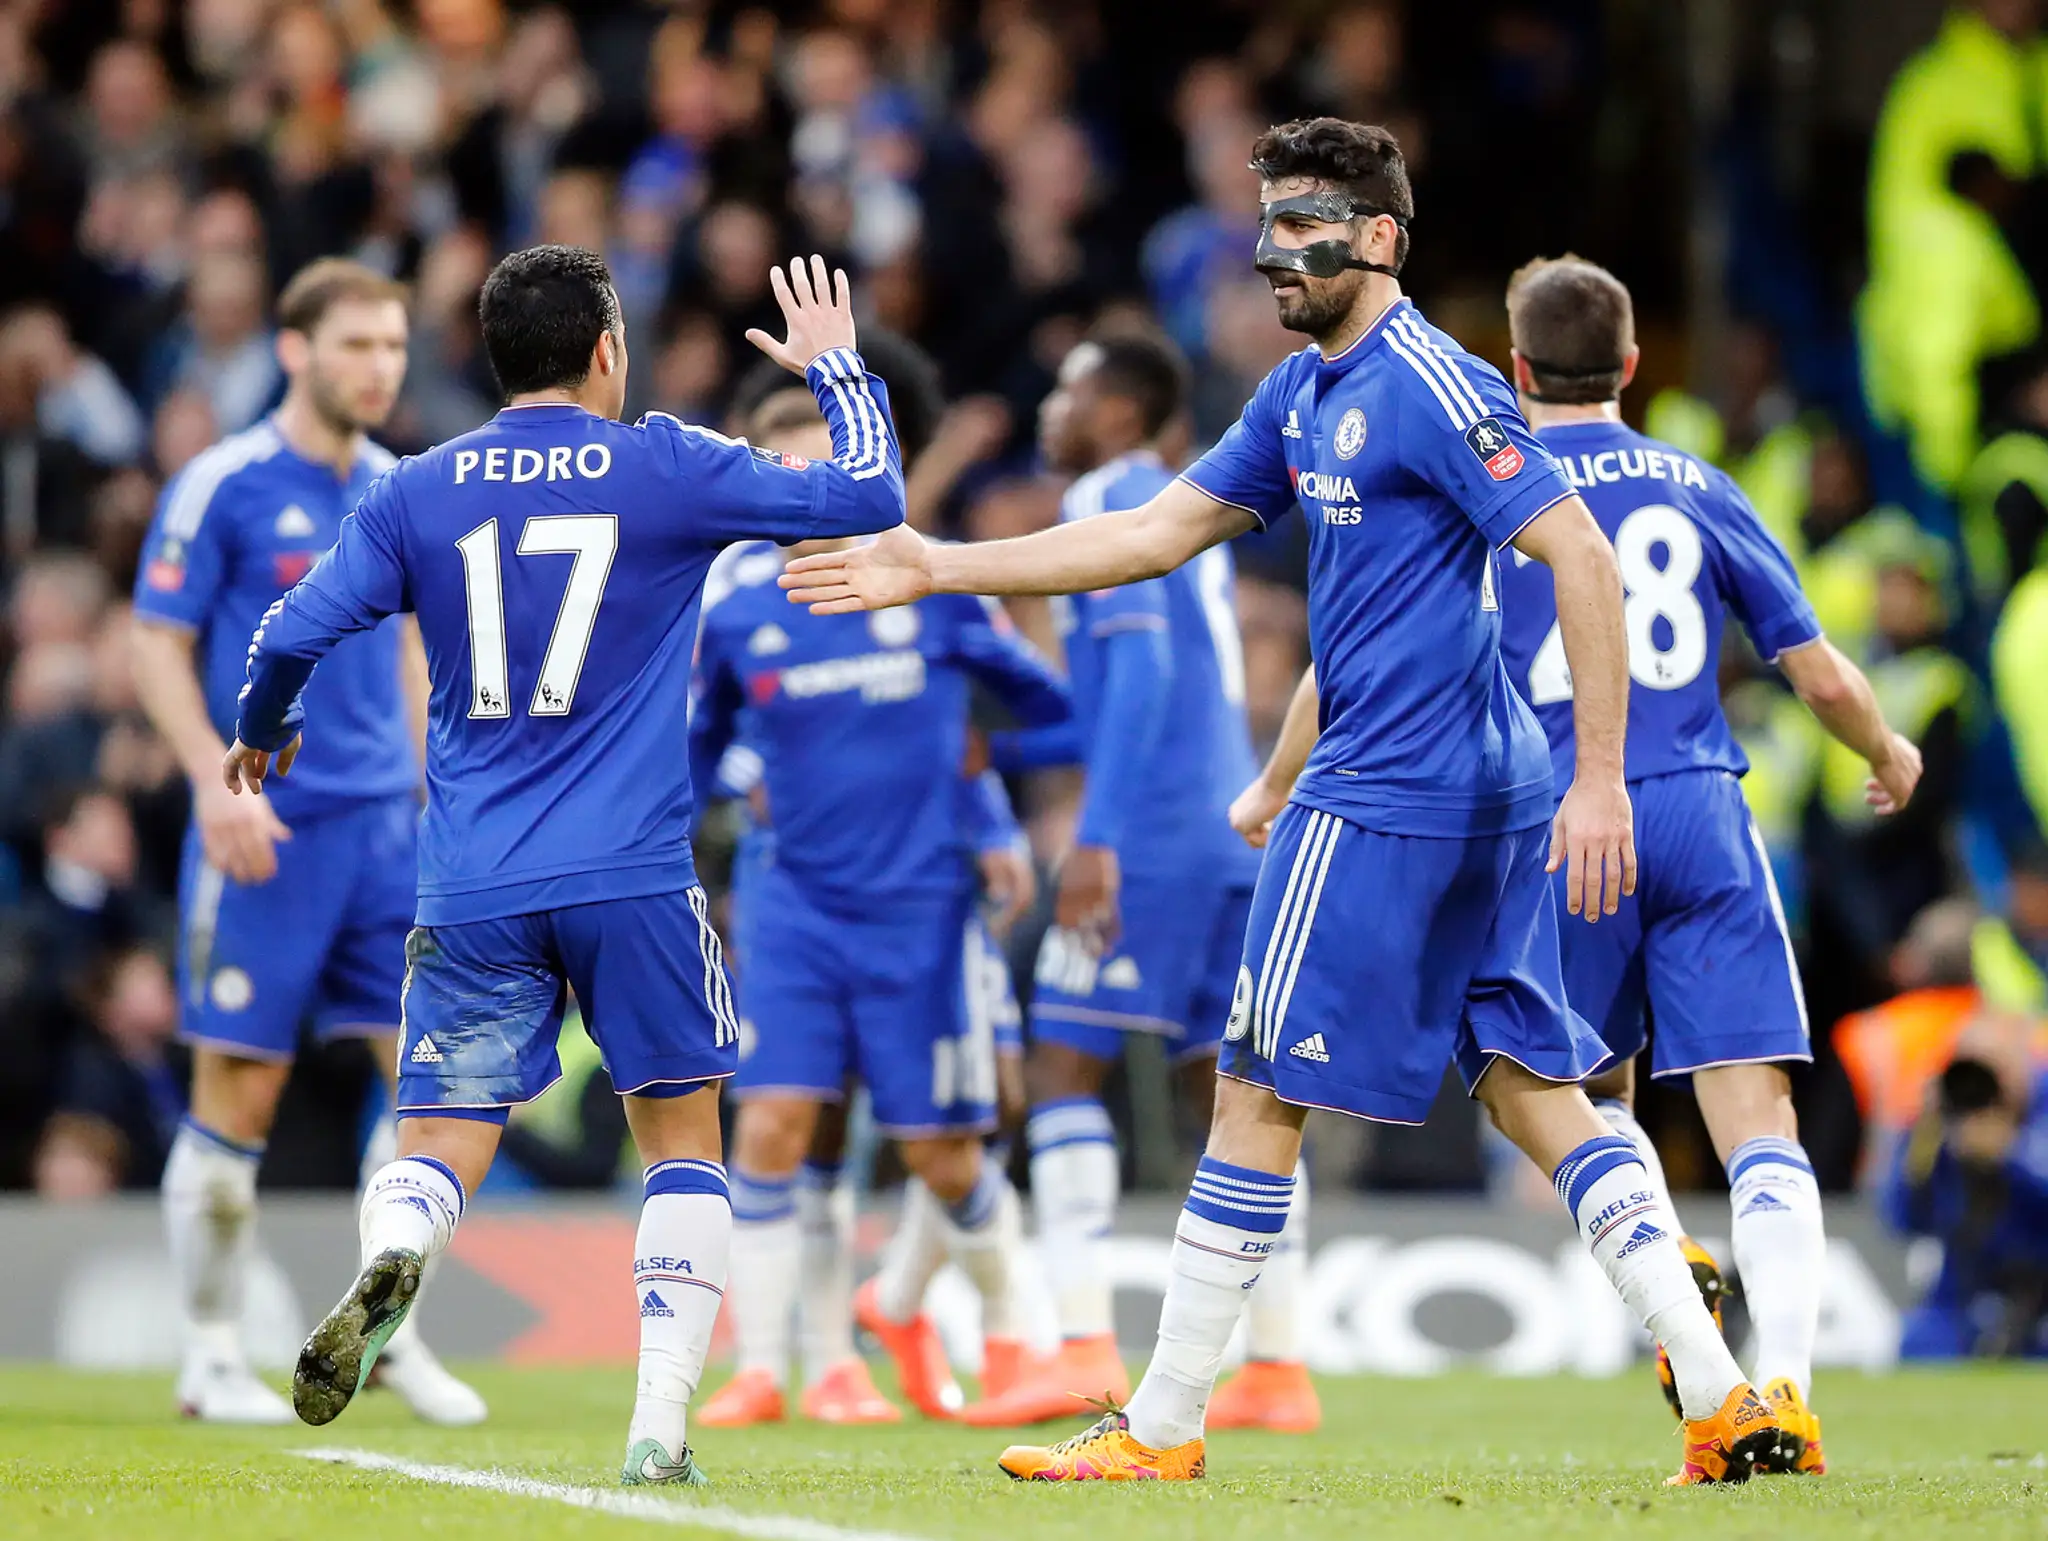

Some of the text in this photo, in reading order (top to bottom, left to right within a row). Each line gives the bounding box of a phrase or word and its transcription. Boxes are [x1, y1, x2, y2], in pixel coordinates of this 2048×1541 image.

[454, 443, 612, 485] PEDRO
[1556, 449, 1709, 491] LICUETA
[454, 514, 619, 720] 17
[1289, 1046, 1331, 1063] adidas
[1616, 1230, 1668, 1259] adidas
